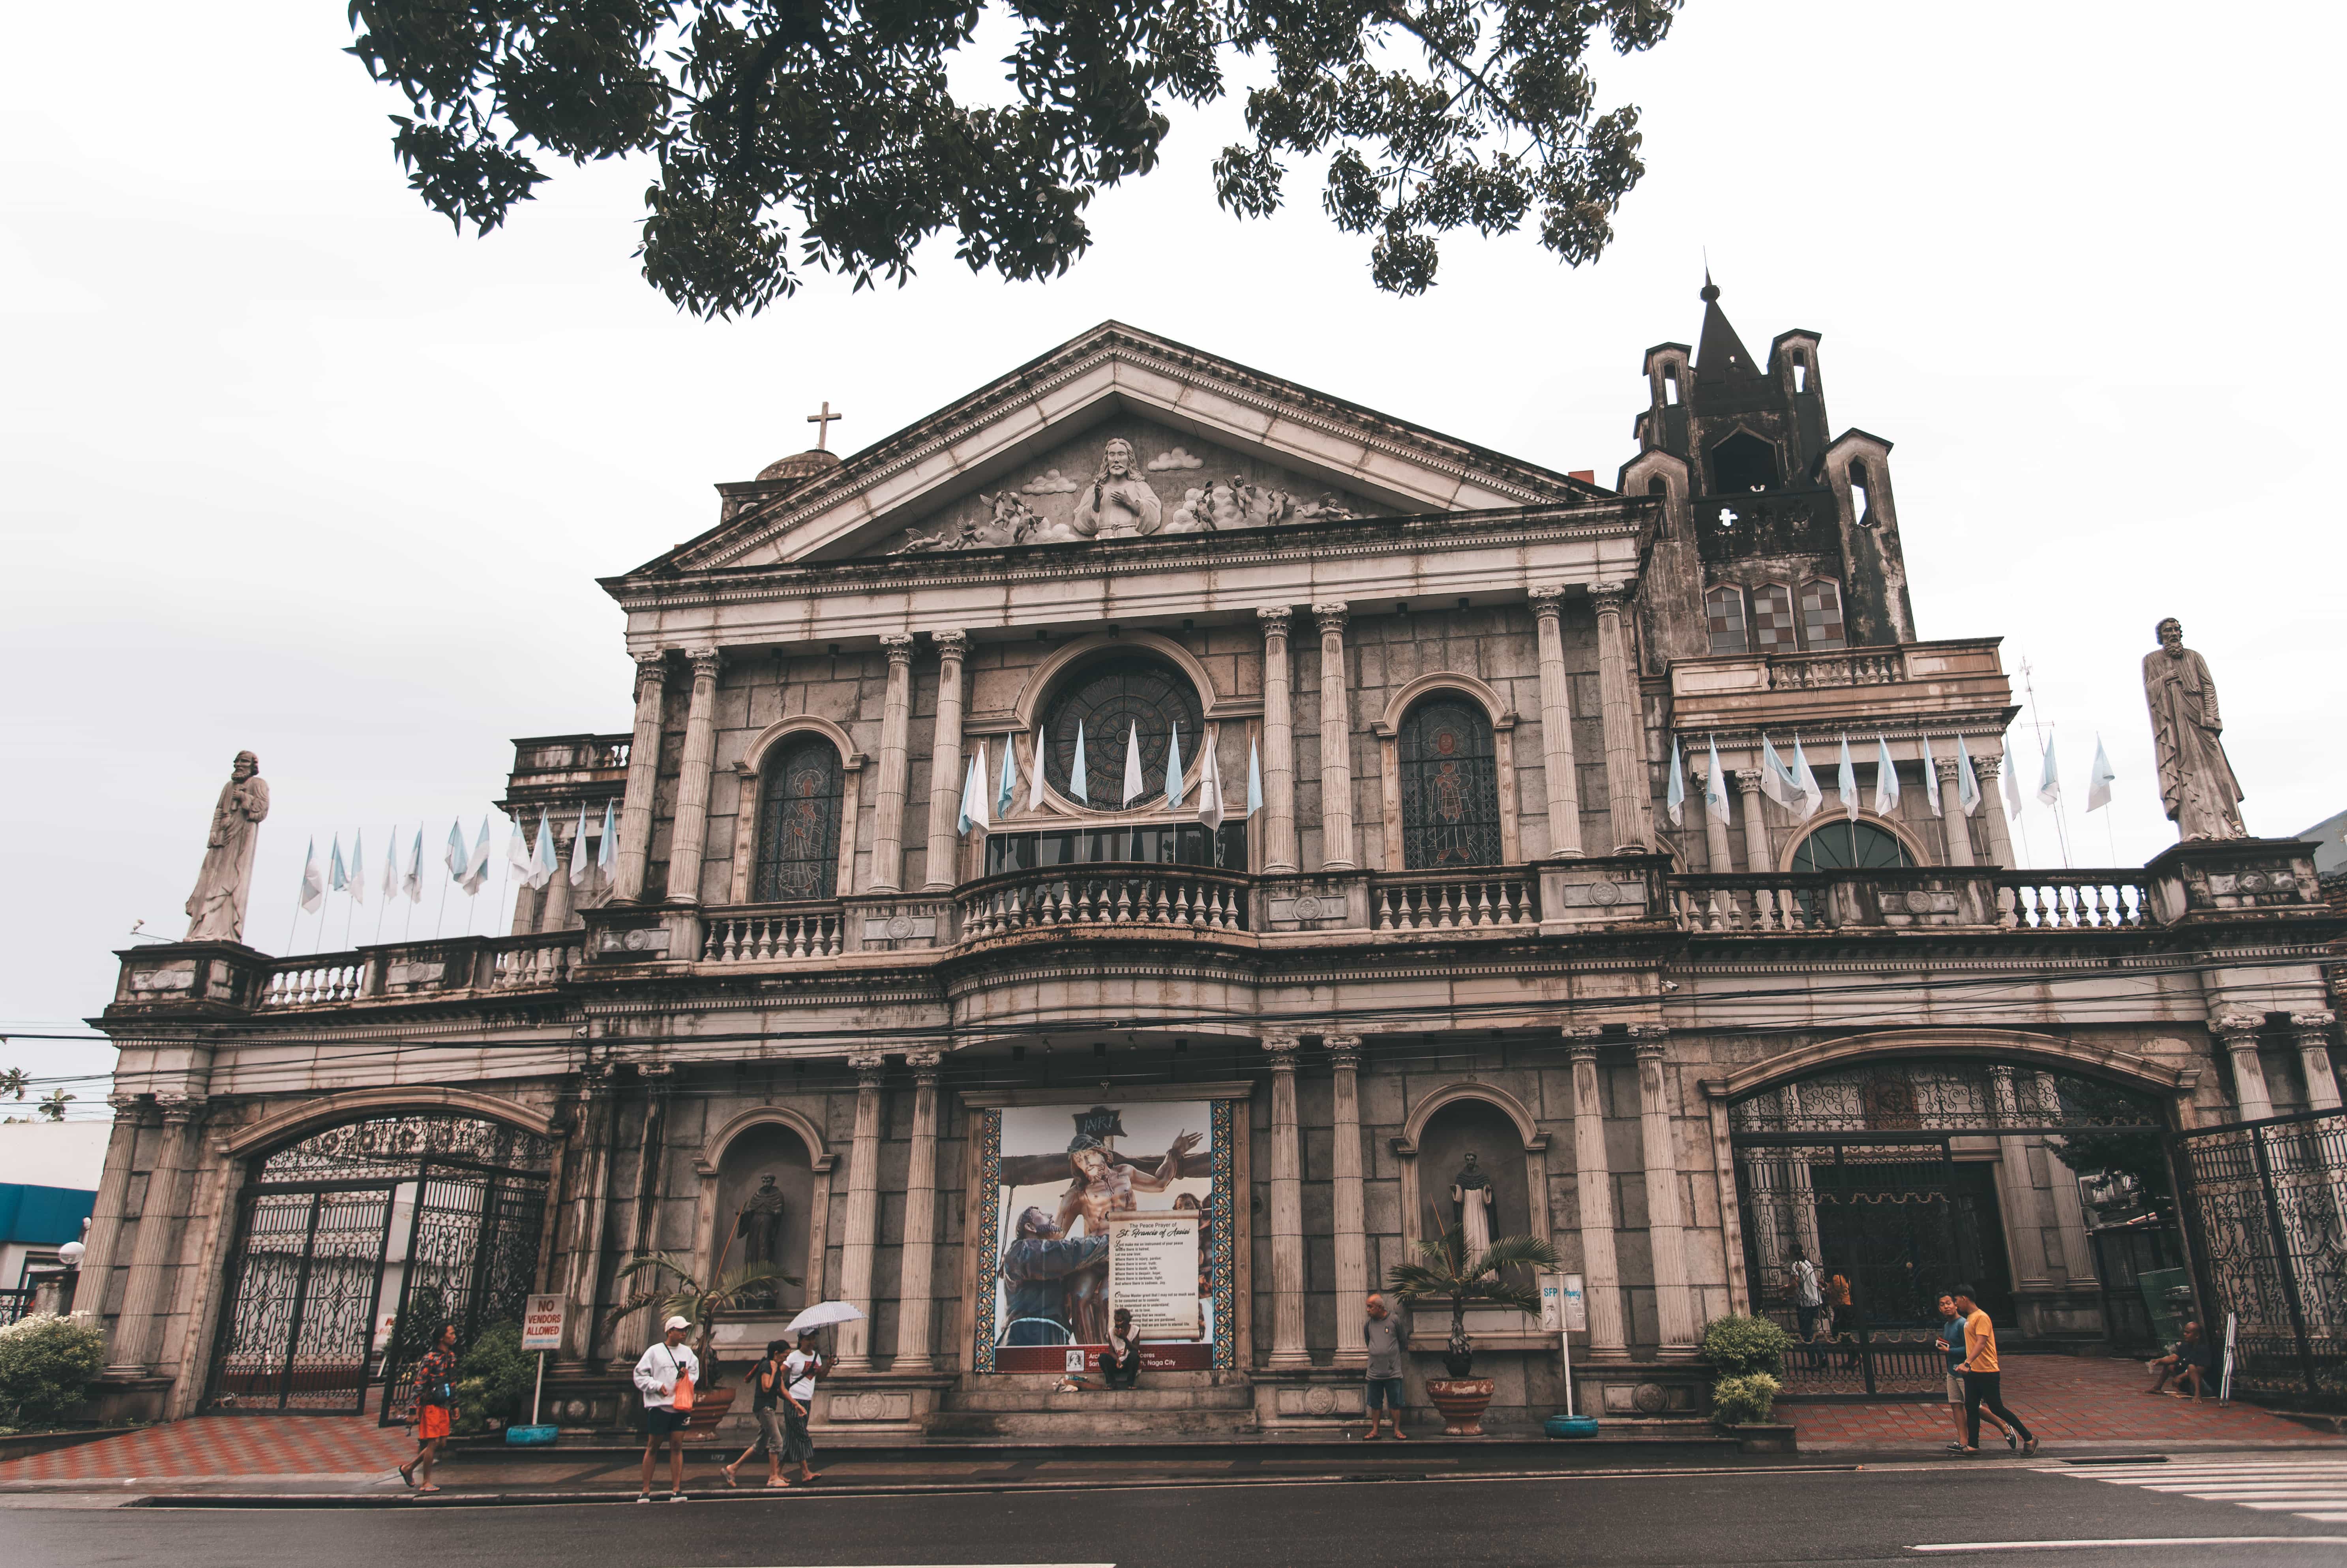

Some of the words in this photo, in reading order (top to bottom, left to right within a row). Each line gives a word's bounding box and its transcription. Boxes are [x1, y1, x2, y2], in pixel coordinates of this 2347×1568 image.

[1116, 1229, 1129, 1238] St.
[1131, 1228, 1157, 1238] Francis
[1159, 1229, 1166, 1238] of
[1167, 1228, 1190, 1237] Assisi
[1544, 1288, 1558, 1297] SFP
[1563, 1288, 1581, 1300] Property
[538, 1300, 555, 1312] NO
[528, 1314, 561, 1324] VENDORS
[527, 1326, 559, 1336] ALLOWED
